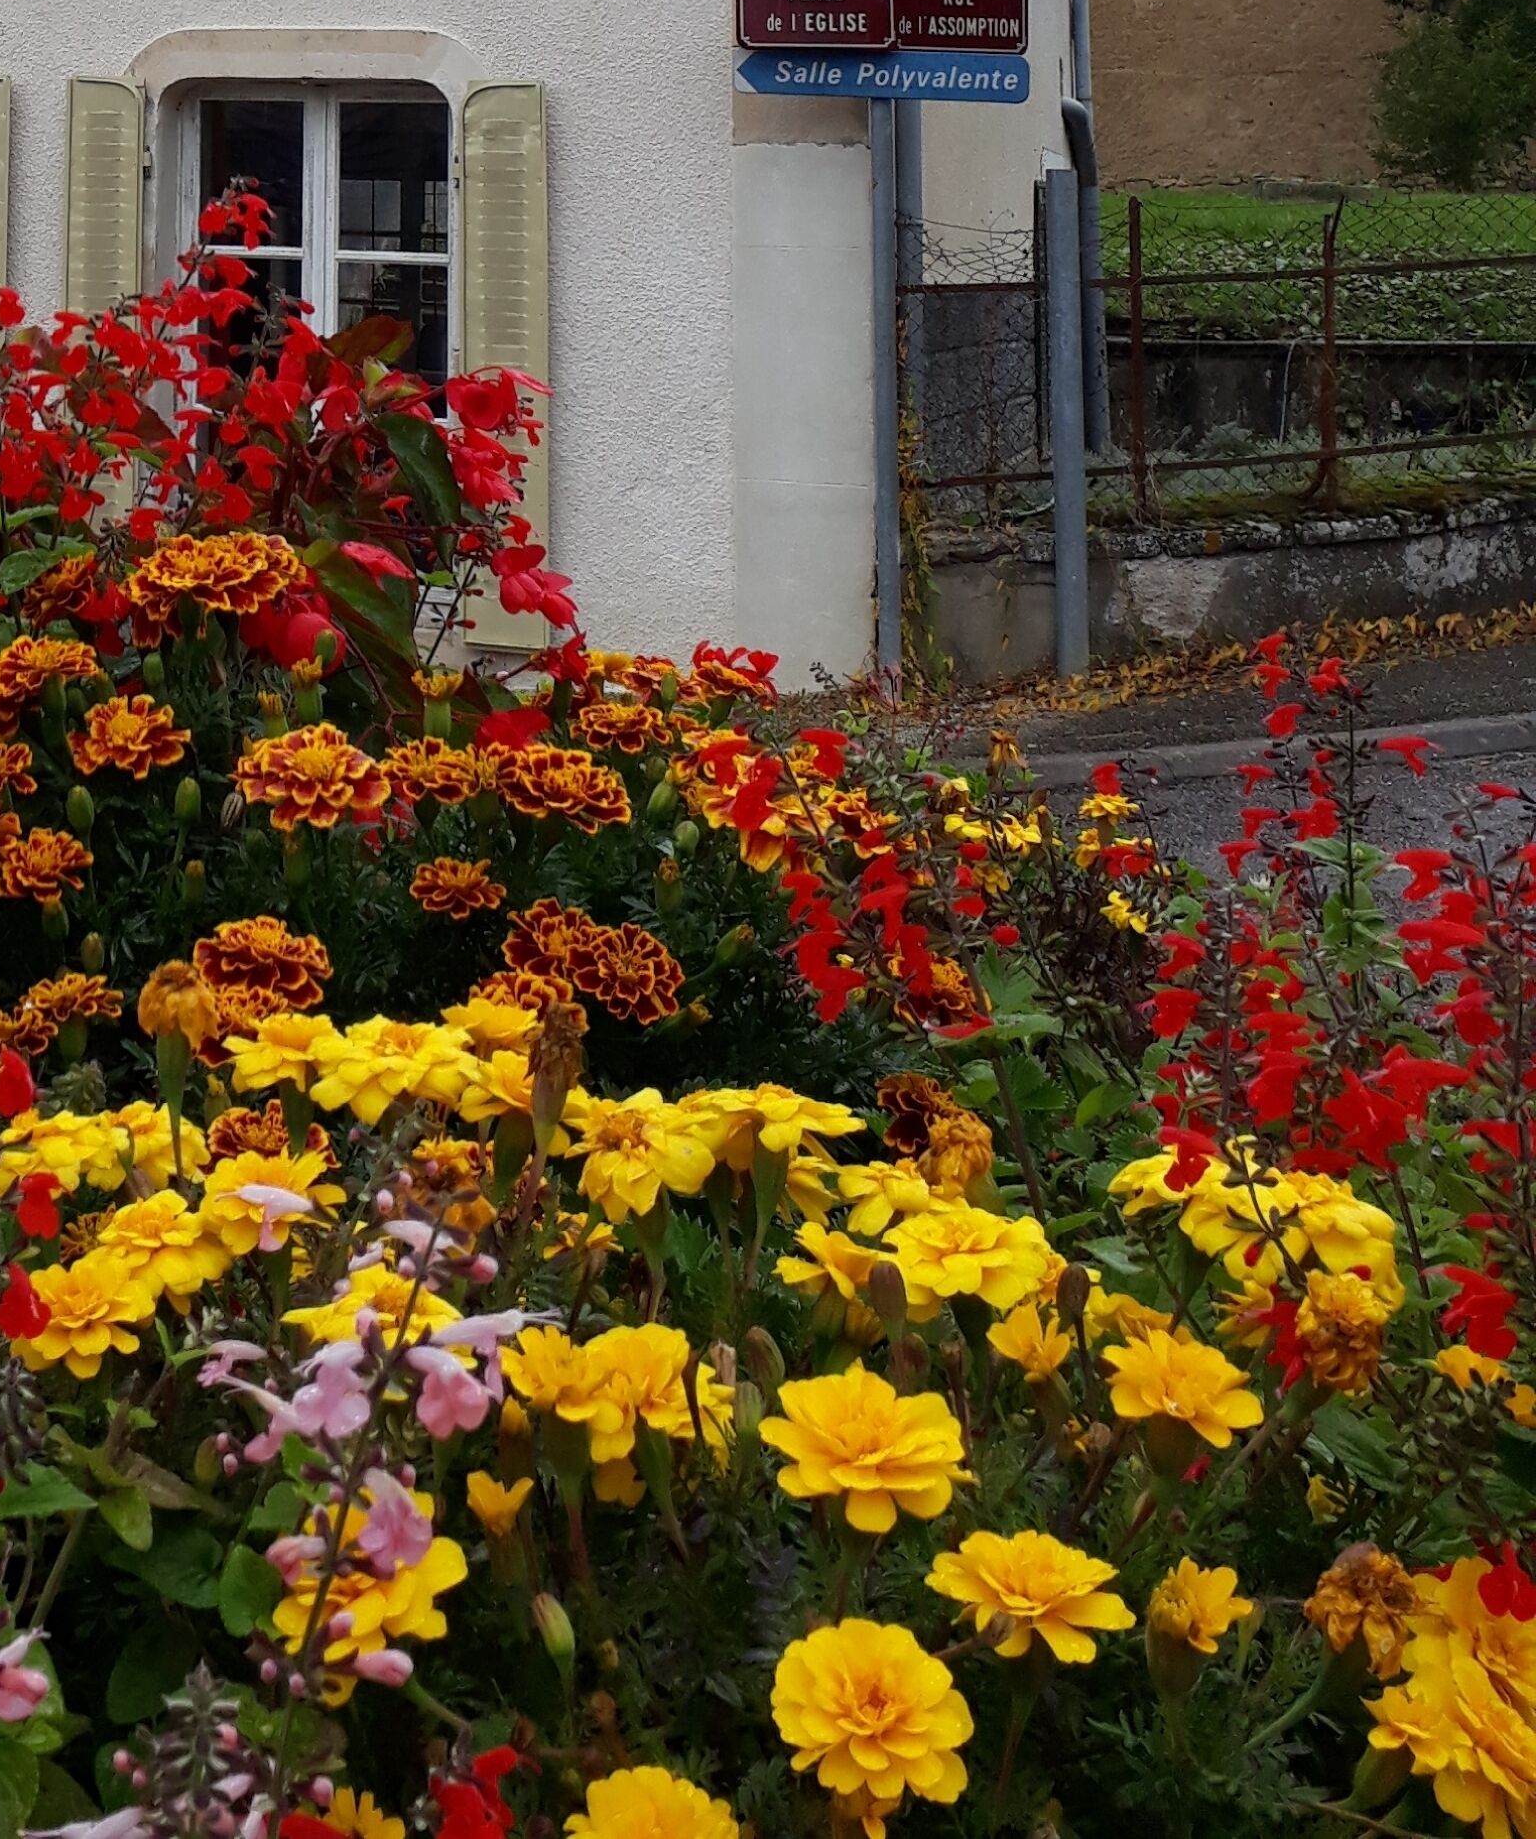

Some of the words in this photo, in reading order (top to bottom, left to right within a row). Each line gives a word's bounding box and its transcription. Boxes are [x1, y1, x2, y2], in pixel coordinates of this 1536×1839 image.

[766, 14, 782, 32] de
[898, 16, 912, 34] de
[775, 60, 842, 85] Salle
[856, 64, 1019, 92] Polyvalente
